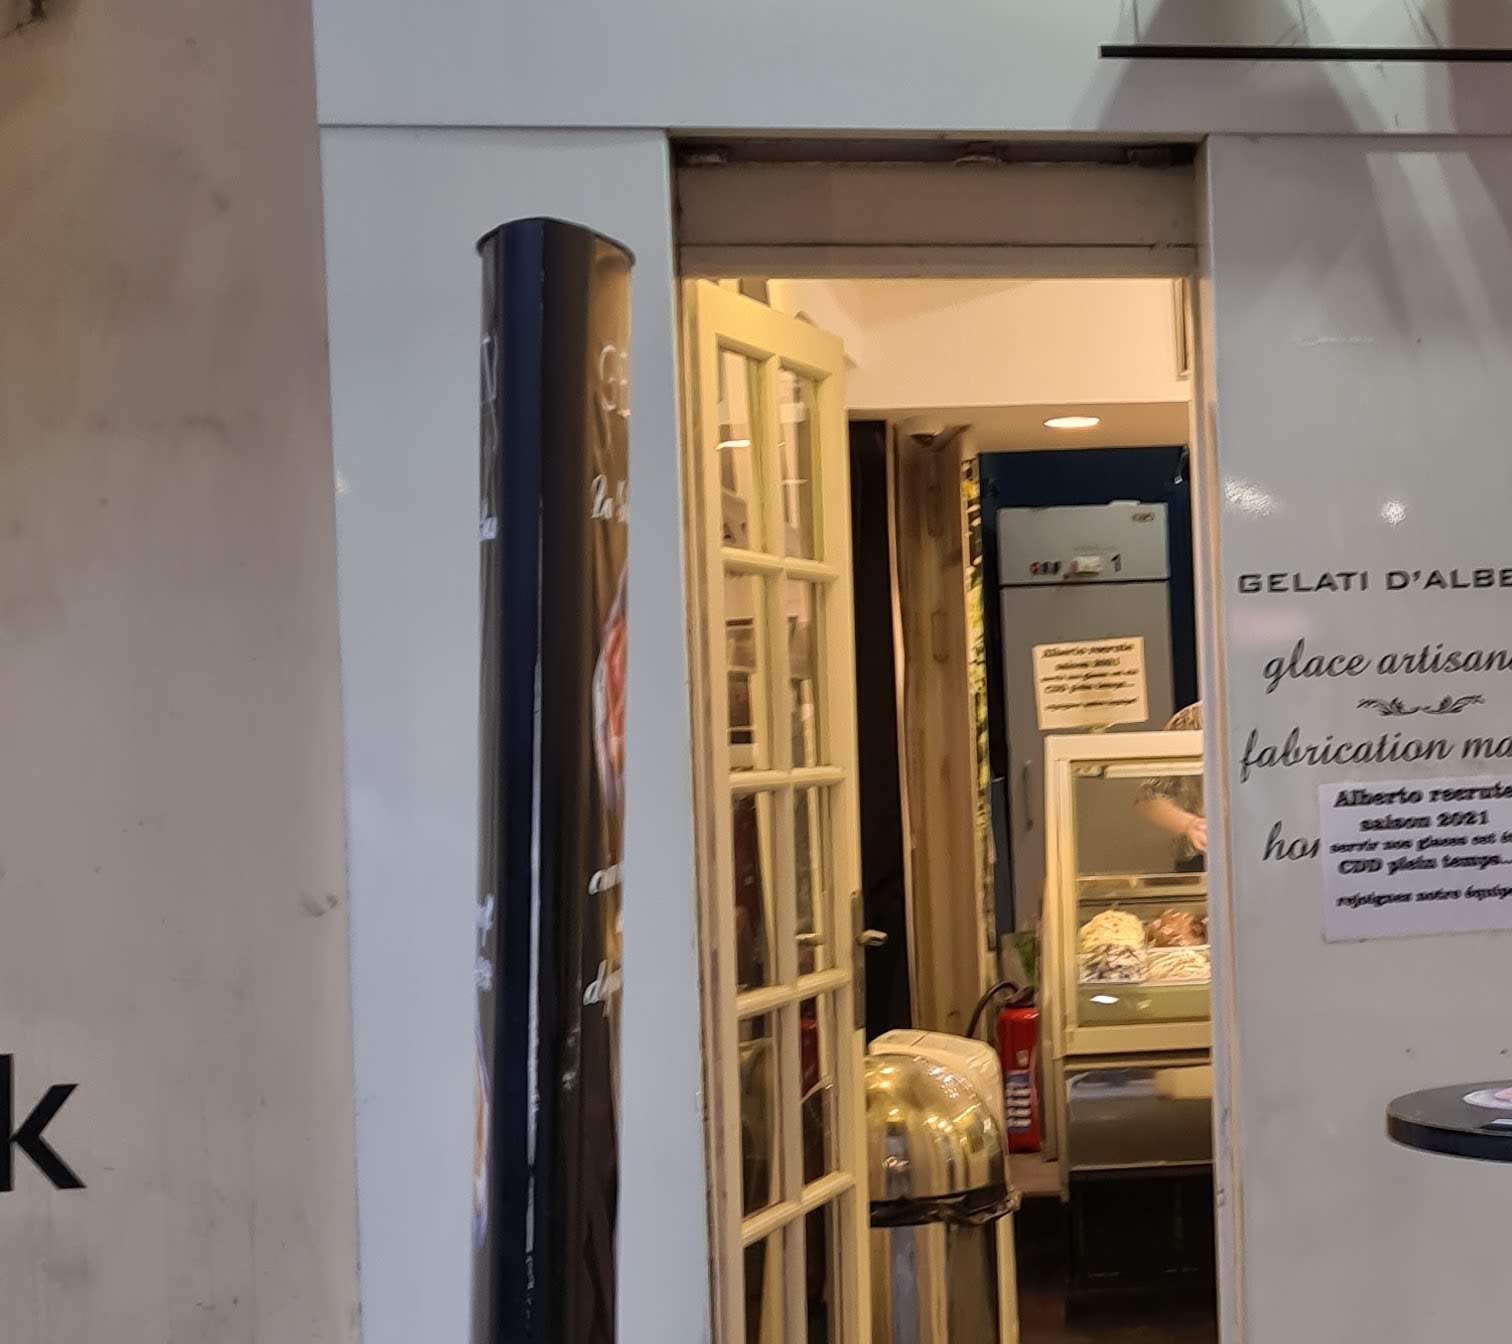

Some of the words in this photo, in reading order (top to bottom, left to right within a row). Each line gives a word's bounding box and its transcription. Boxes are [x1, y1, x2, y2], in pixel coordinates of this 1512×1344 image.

[1238, 570, 1369, 593] GELATI
[1262, 637, 1371, 694] glace
[1239, 727, 1454, 784] fabrication
[1333, 787, 1424, 807] Alberto
[1436, 809, 1489, 828] 2021
[1338, 858, 1382, 875] CDD
